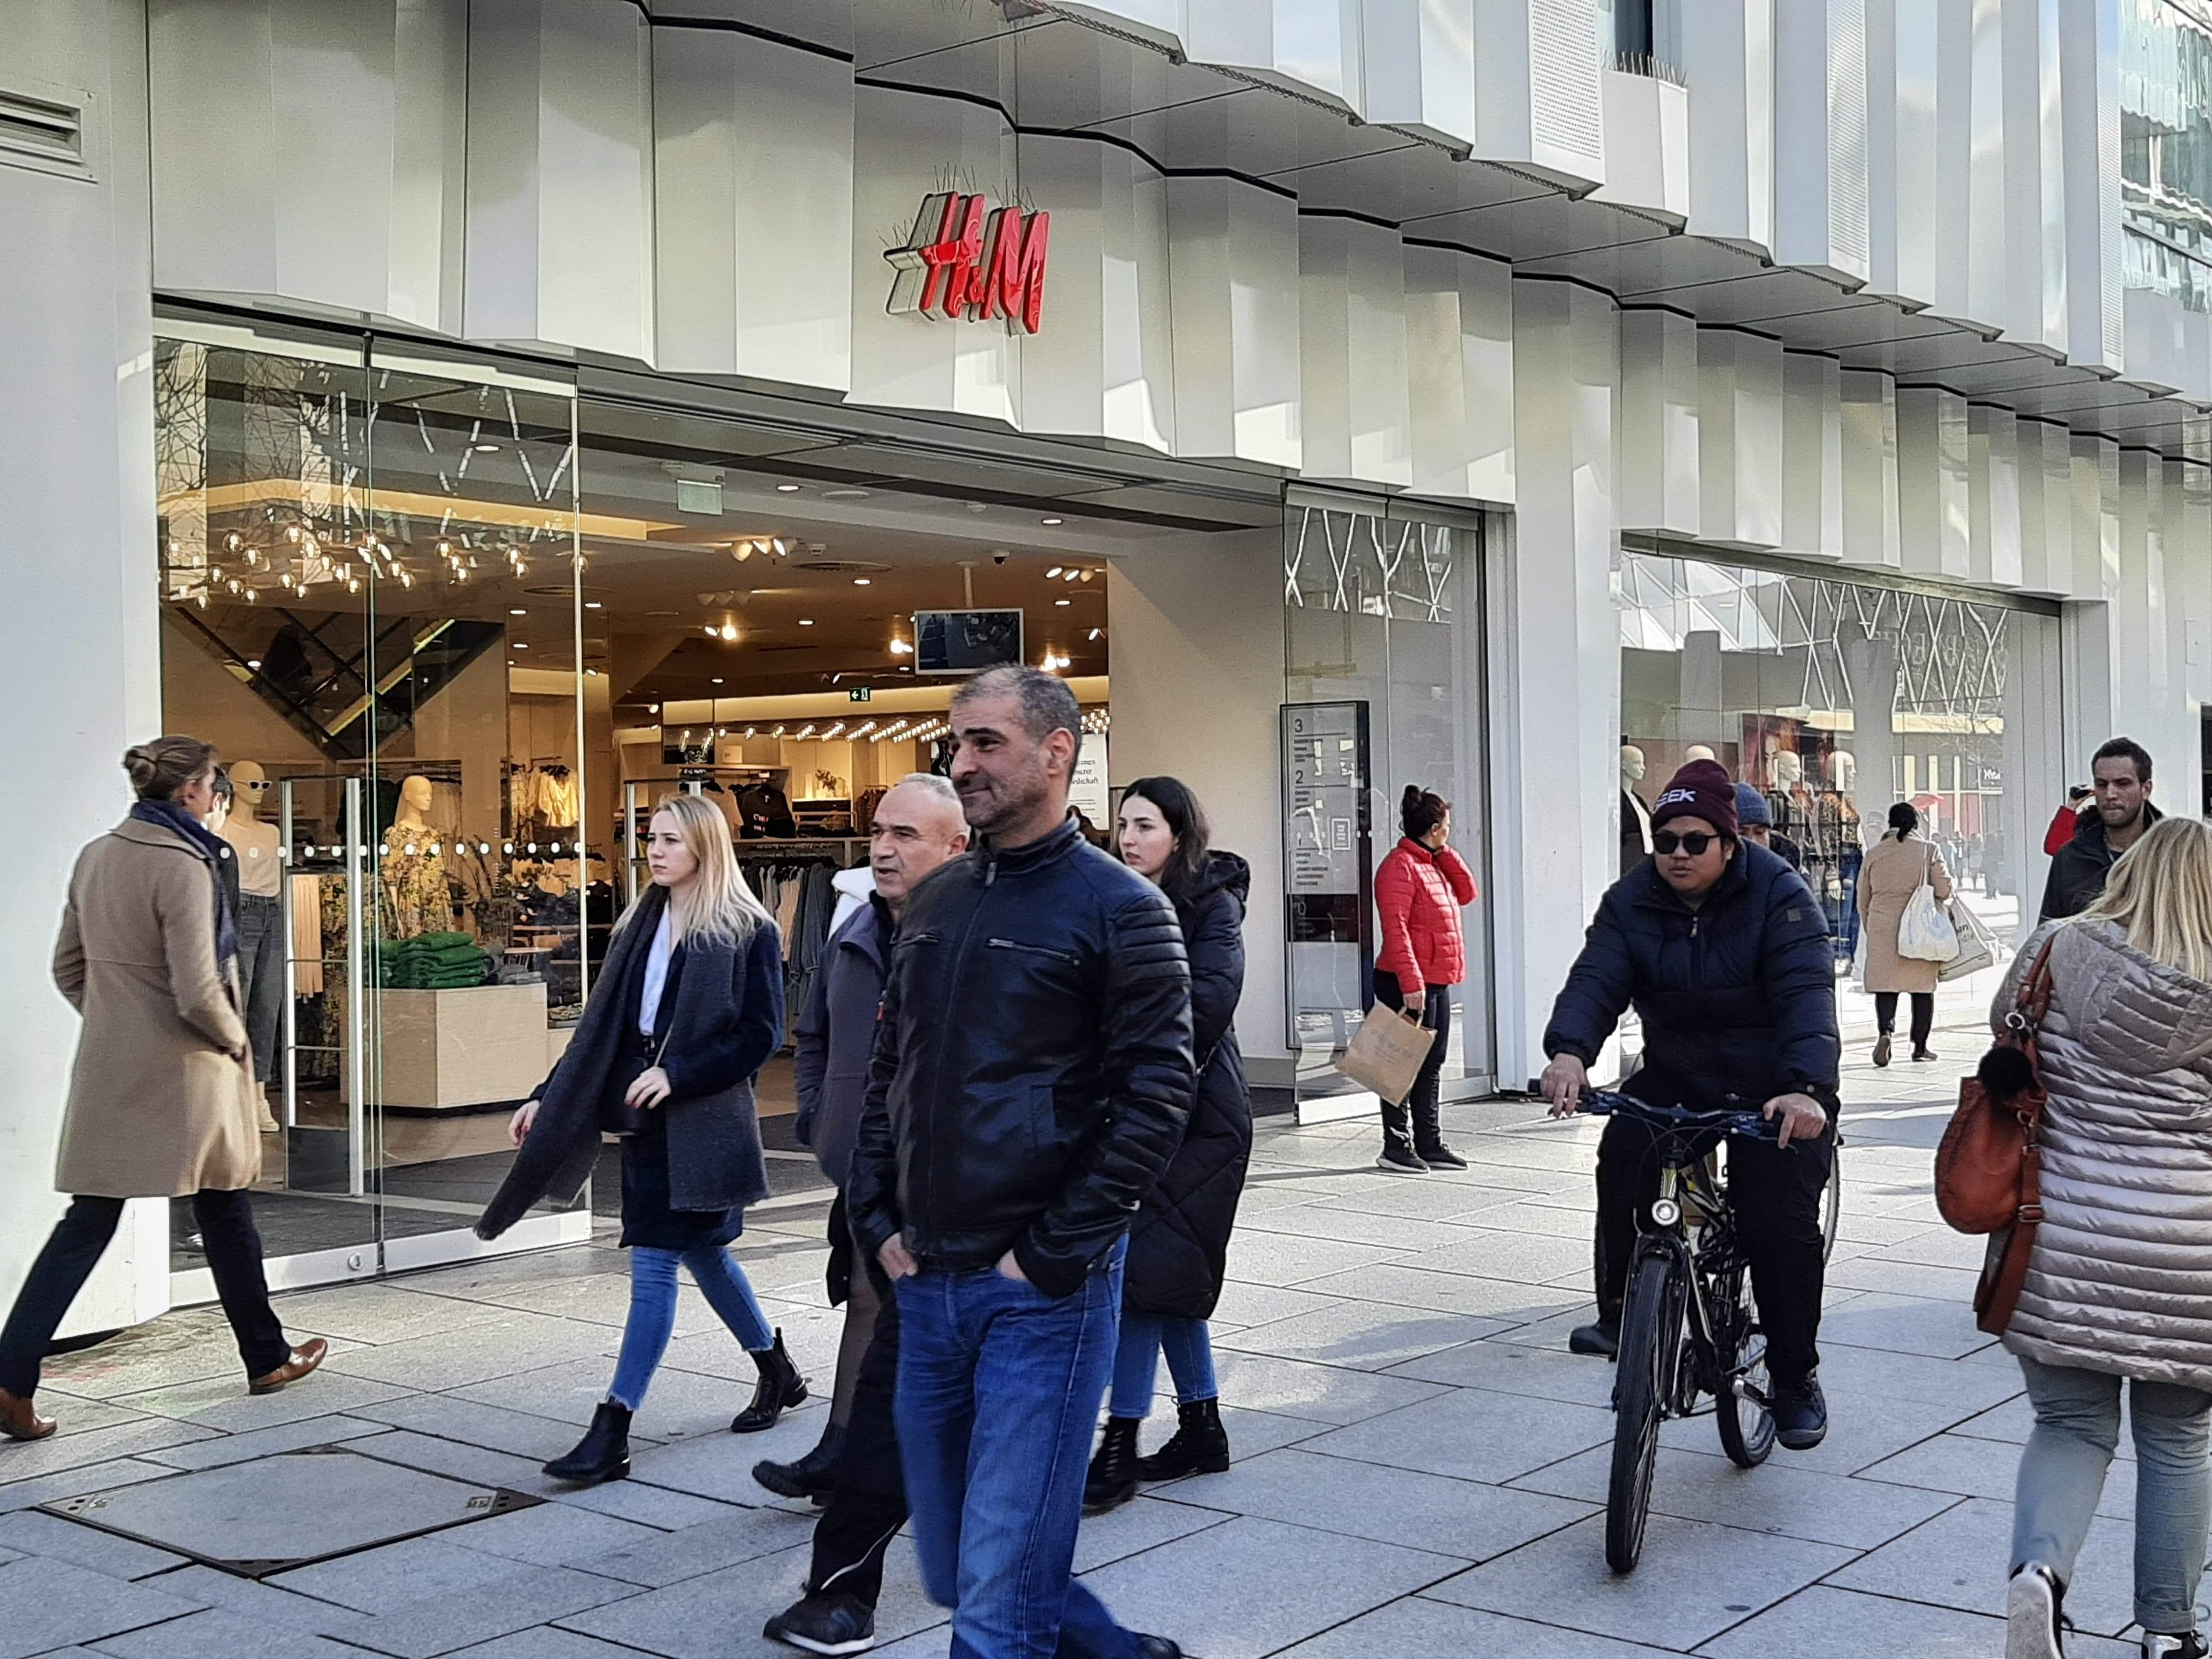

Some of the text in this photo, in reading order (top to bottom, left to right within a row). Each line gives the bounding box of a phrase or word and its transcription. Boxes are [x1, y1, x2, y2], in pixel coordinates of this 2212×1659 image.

[915, 191, 1050, 334] H&M
[1295, 718, 1303, 733] 3
[1295, 770, 1303, 784] 2
